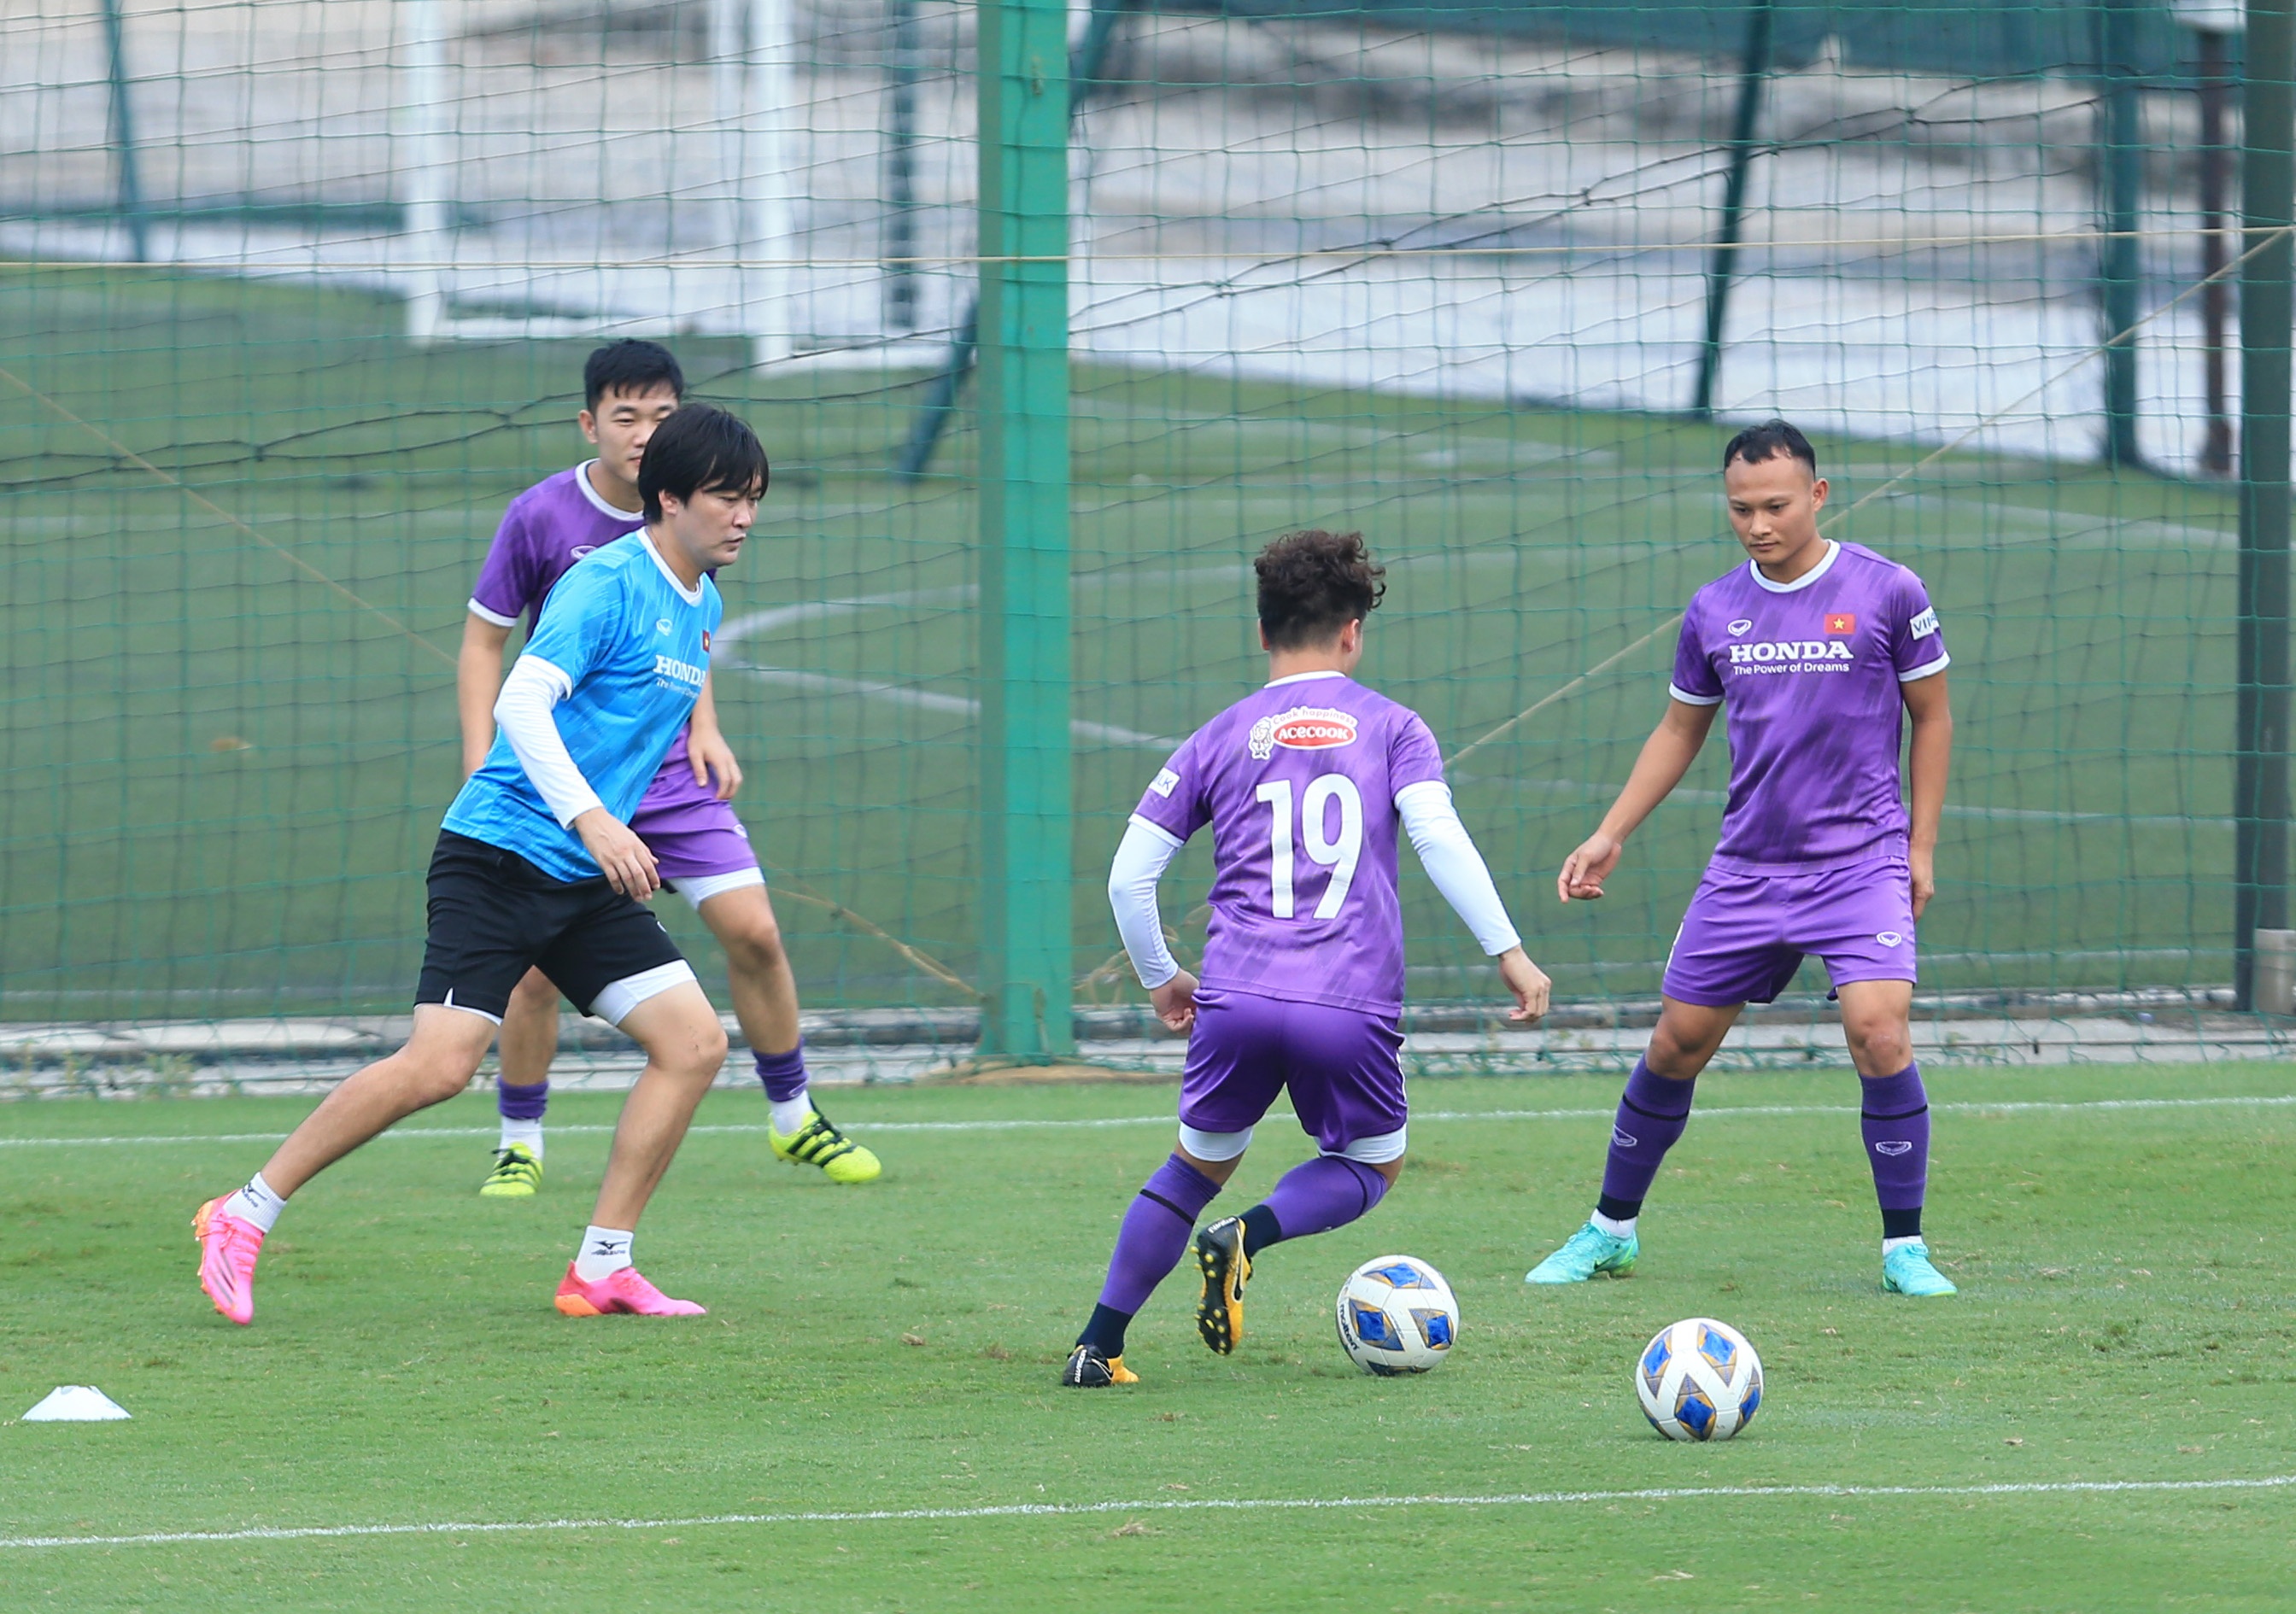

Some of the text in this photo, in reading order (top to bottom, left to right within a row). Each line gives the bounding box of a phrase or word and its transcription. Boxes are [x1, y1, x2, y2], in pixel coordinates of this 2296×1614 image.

[1730, 640, 1854, 663] HONDA
[1733, 663, 1850, 675] The Power of Dreams
[1273, 708, 1355, 725] Cook happiness
[1256, 773, 1363, 919] 19
[1339, 1304, 1360, 1350] molten
